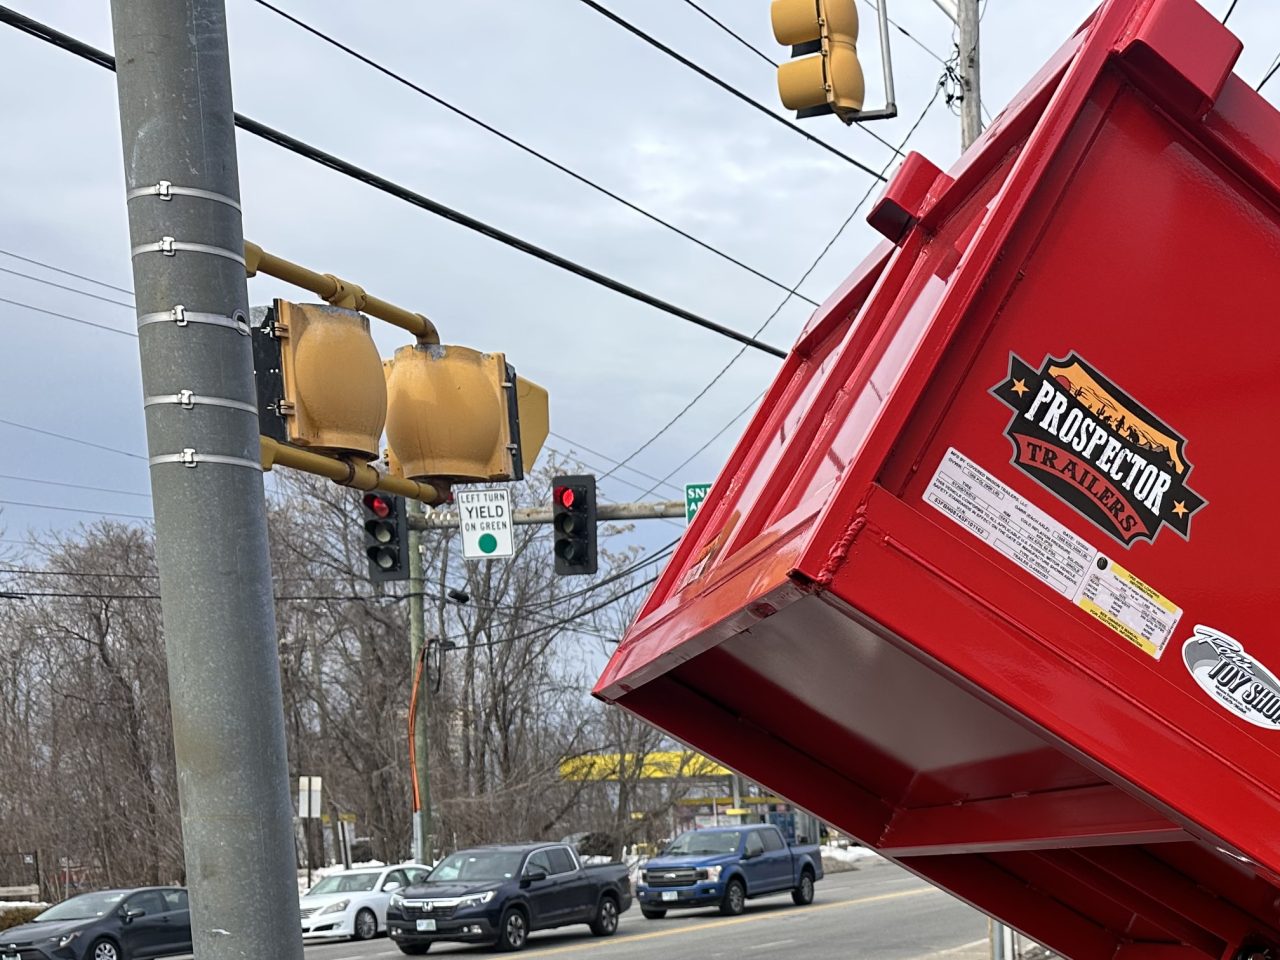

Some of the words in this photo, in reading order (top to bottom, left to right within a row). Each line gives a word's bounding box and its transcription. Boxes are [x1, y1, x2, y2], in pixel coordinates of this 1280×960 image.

[1024, 379, 1172, 517] PROSPECTOR
[461, 494, 480, 503] LEFT
[484, 493, 505, 502] TURN
[1026, 440, 1137, 541] TRAILERS
[466, 505, 504, 519] YIELD
[465, 522, 476, 532] ON
[480, 521, 508, 531] GREEN
[1208, 656, 1252, 694] TOY
